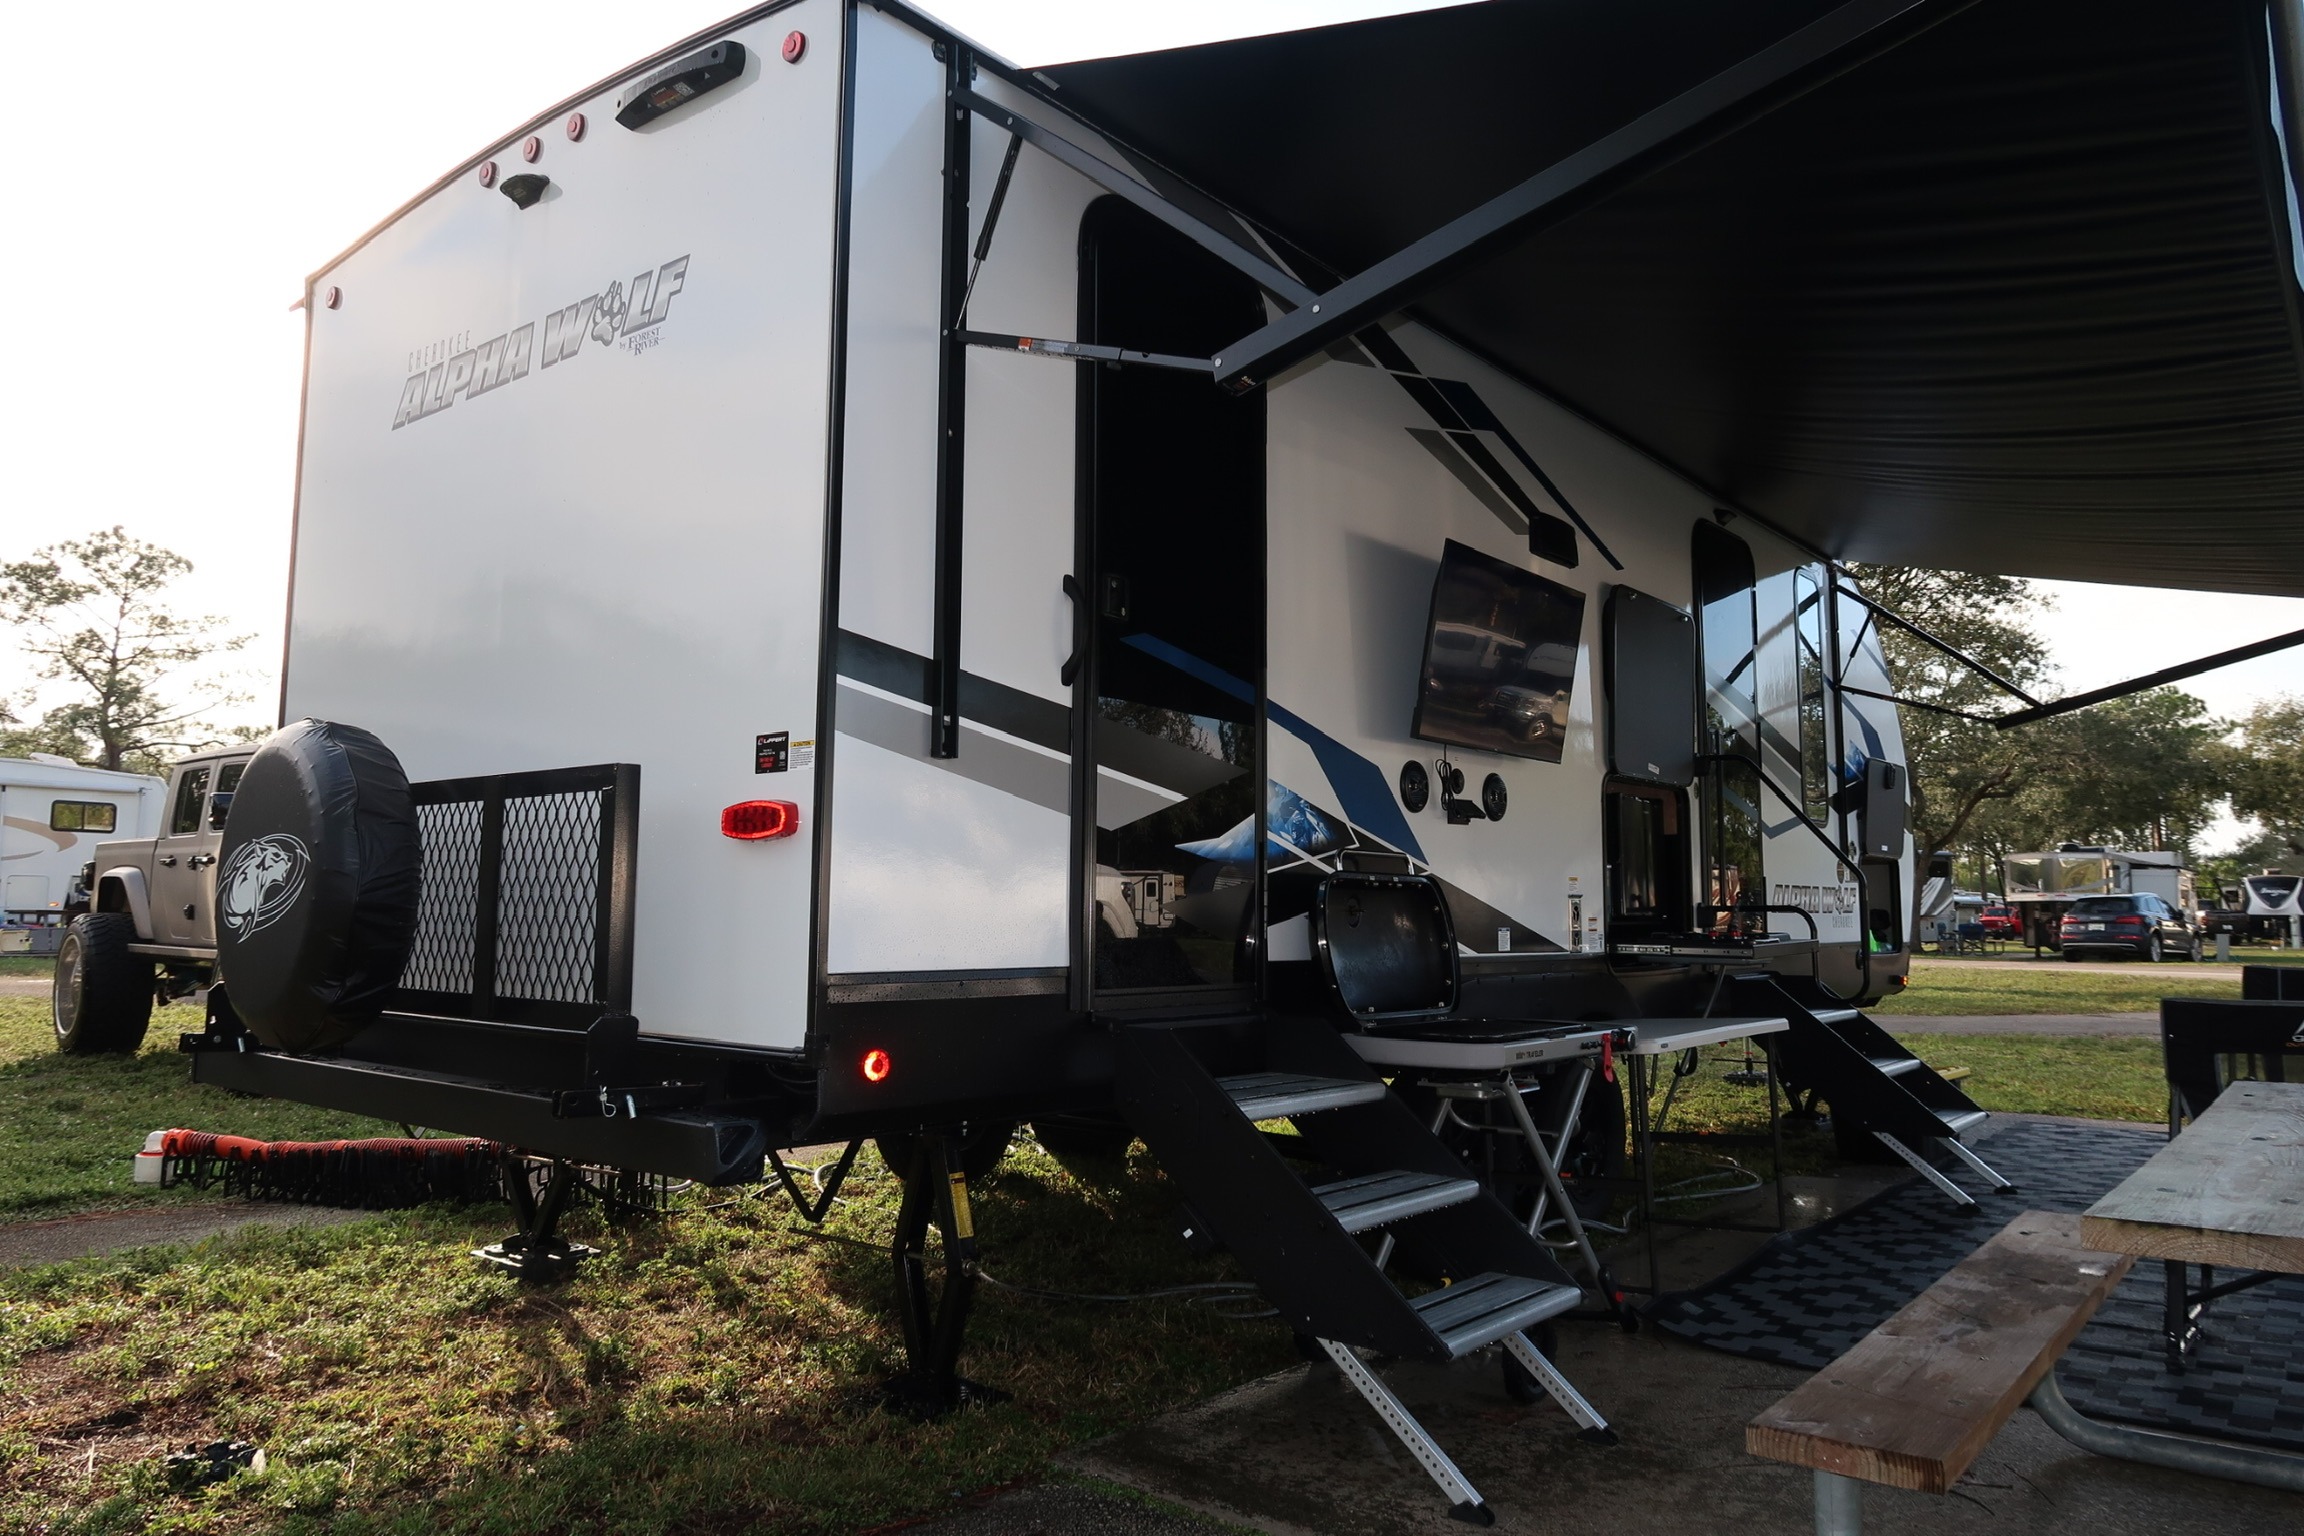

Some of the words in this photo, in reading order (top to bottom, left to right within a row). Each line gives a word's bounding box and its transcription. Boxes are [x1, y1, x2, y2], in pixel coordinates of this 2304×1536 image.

[408, 329, 471, 373] CHEROKEE
[628, 326, 661, 349] FOREST
[634, 336, 659, 356] RIVER
[391, 321, 535, 431] ALPHA
